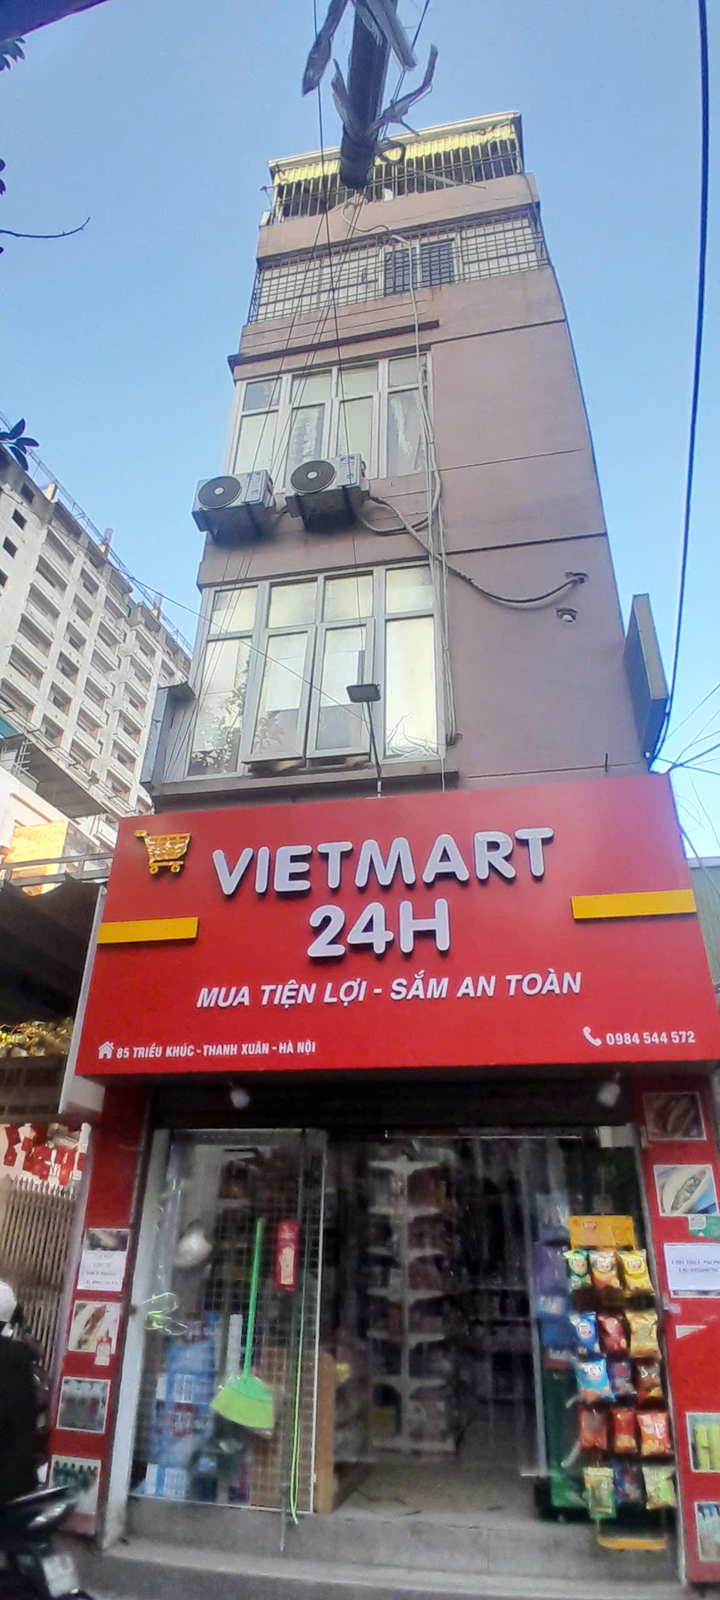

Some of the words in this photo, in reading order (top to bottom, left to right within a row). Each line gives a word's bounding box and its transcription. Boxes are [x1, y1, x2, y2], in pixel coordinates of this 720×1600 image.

[212, 827, 554, 896] VIETMART
[307, 898, 450, 957] 24H
[196, 985, 250, 1008] MUA
[260, 979, 317, 1009] TIỆN
[323, 978, 367, 1007] LỢI
[390, 970, 449, 1000] SẮM
[456, 975, 496, 998] AN
[505, 968, 582, 996] TOÀN
[116, 1047, 130, 1059] 85
[165, 1041, 195, 1057] KHÚC
[203, 1044, 238, 1056] THANH
[241, 1041, 269, 1055] XUÂN
[279, 1039, 294, 1054] HÀ
[297, 1039, 316, 1055] NỘI
[606, 1032, 639, 1045] 0984
[643, 1031, 668, 1044] 544
[671, 1030, 696, 1043] 572
